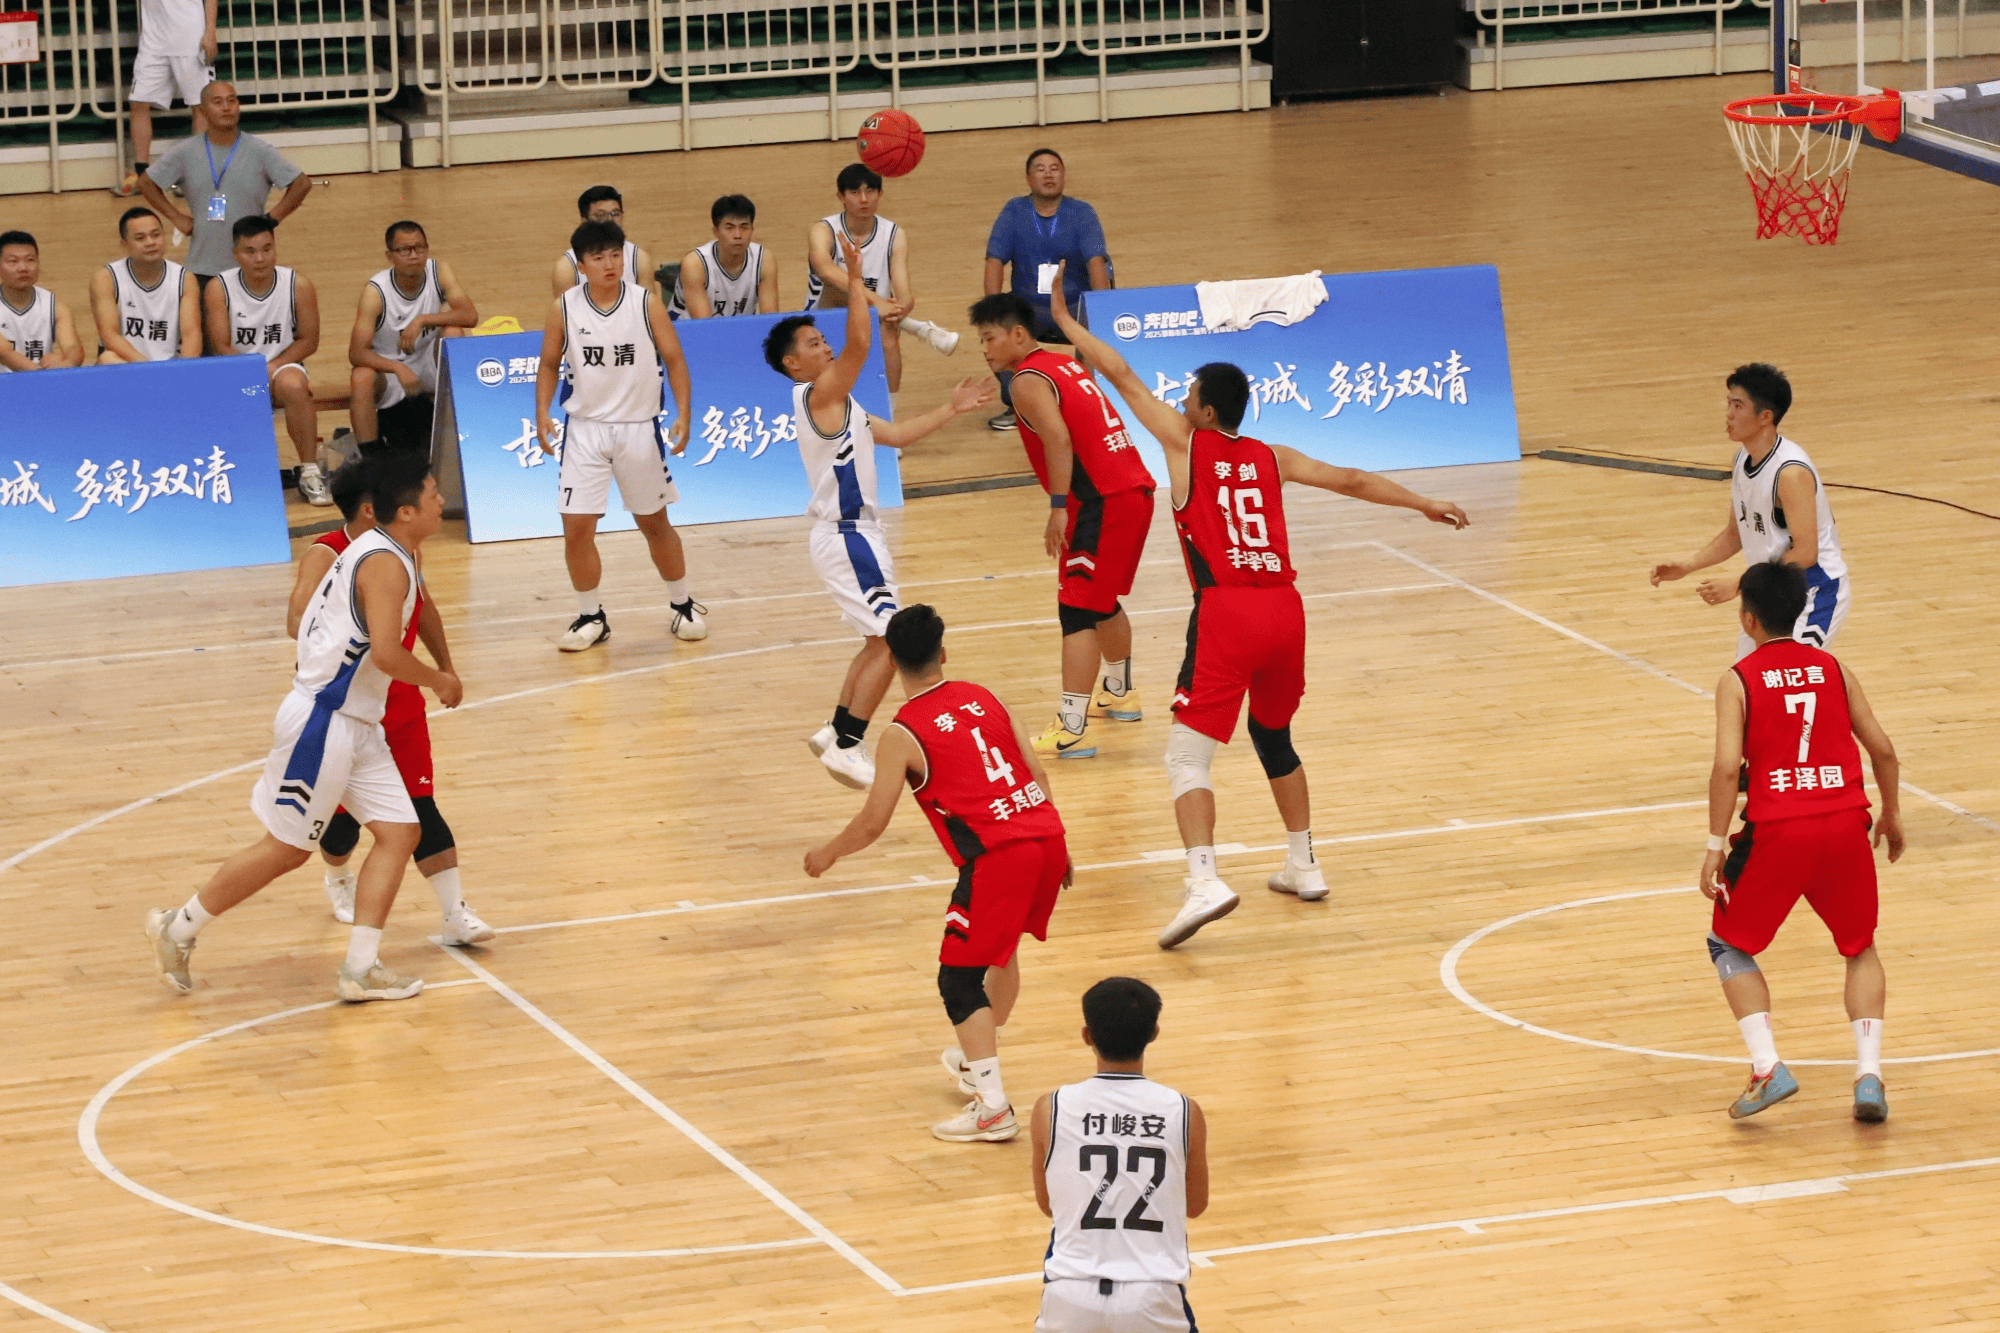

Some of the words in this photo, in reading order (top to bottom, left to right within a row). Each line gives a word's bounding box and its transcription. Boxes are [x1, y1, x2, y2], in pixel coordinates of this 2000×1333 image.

[126, 317, 168, 342] 双清
[1143, 310, 1206, 331] 奔跑吧·
[235, 323, 282, 346] 双清
[582, 343, 635, 367] 双清
[1319, 349, 1472, 421] 多彩双清
[65, 445, 236, 522] 多彩双清
[1214, 461, 1258, 482] 李剑
[564, 487, 573, 507] 7
[1226, 546, 1282, 573] 丰泽园
[1761, 665, 1826, 689] 谢记言
[933, 701, 986, 733] 李飞
[1783, 691, 1818, 764] 7
[970, 726, 1017, 788] 4
[1769, 765, 1845, 793] 丰泽园
[988, 780, 1047, 822] 丰泽园
[309, 819, 324, 841] 3
[1081, 1113, 1167, 1140] 付峻安
[1079, 1144, 1168, 1234] 22
